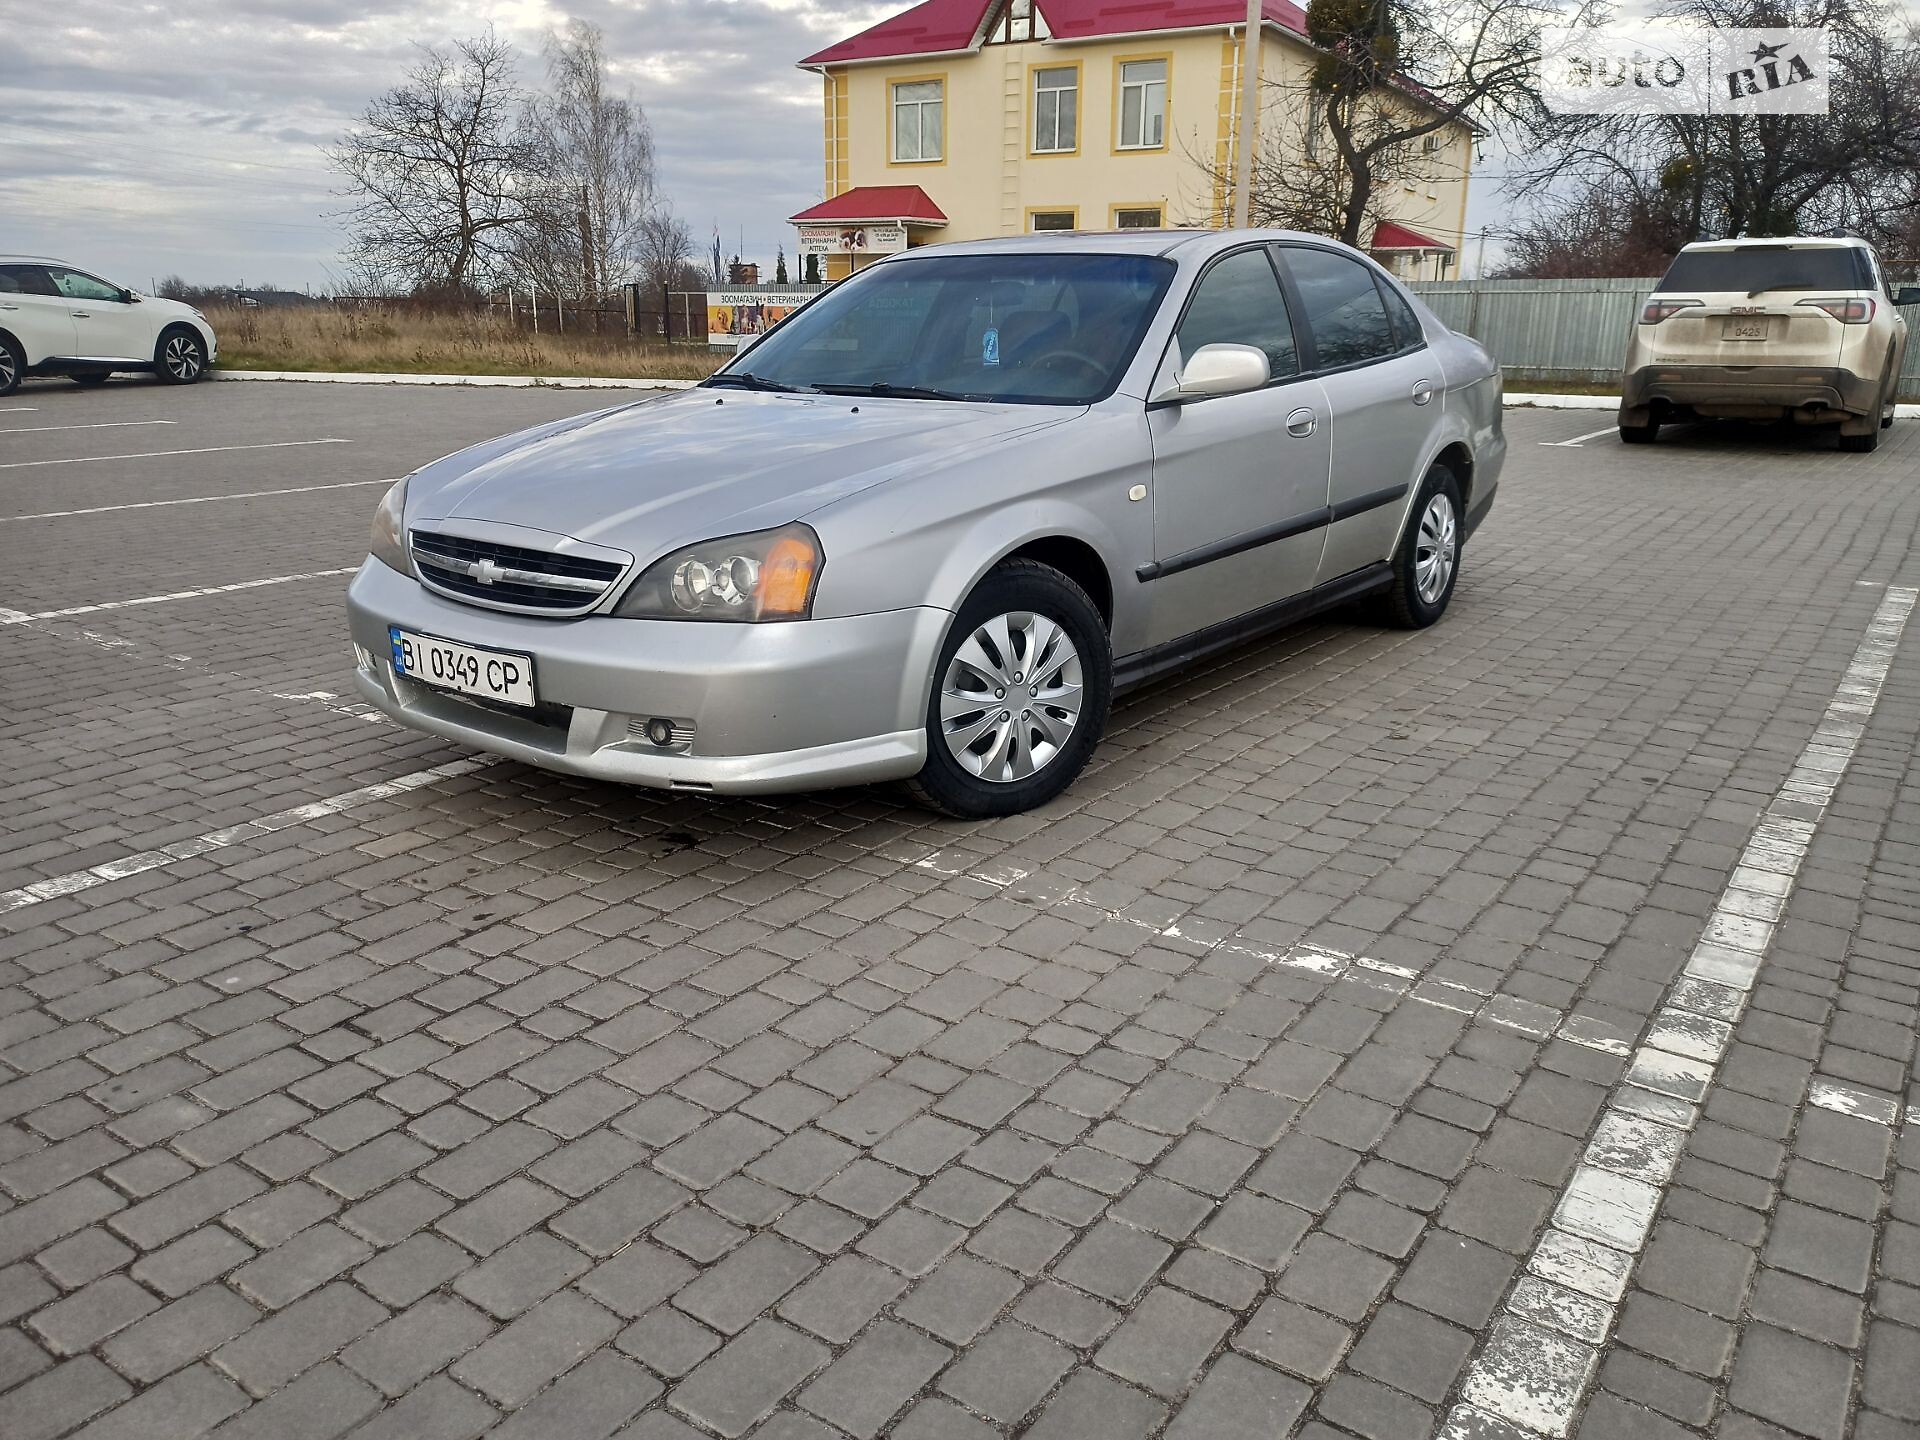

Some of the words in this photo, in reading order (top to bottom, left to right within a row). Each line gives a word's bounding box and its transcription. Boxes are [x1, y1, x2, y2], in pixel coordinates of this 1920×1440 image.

[800, 229, 837, 237] ЗООМАГАЗИН
[800, 237, 837, 245] ВЕТЕРИНАРНА
[808, 244, 829, 252] АПТЕКА
[721, 295, 762, 304] ЗООМАГАЗИН
[1730, 306, 1766, 315] GMC
[402, 638, 424, 674] BI
[431, 647, 479, 687] 0349
[487, 659, 520, 694] CP
